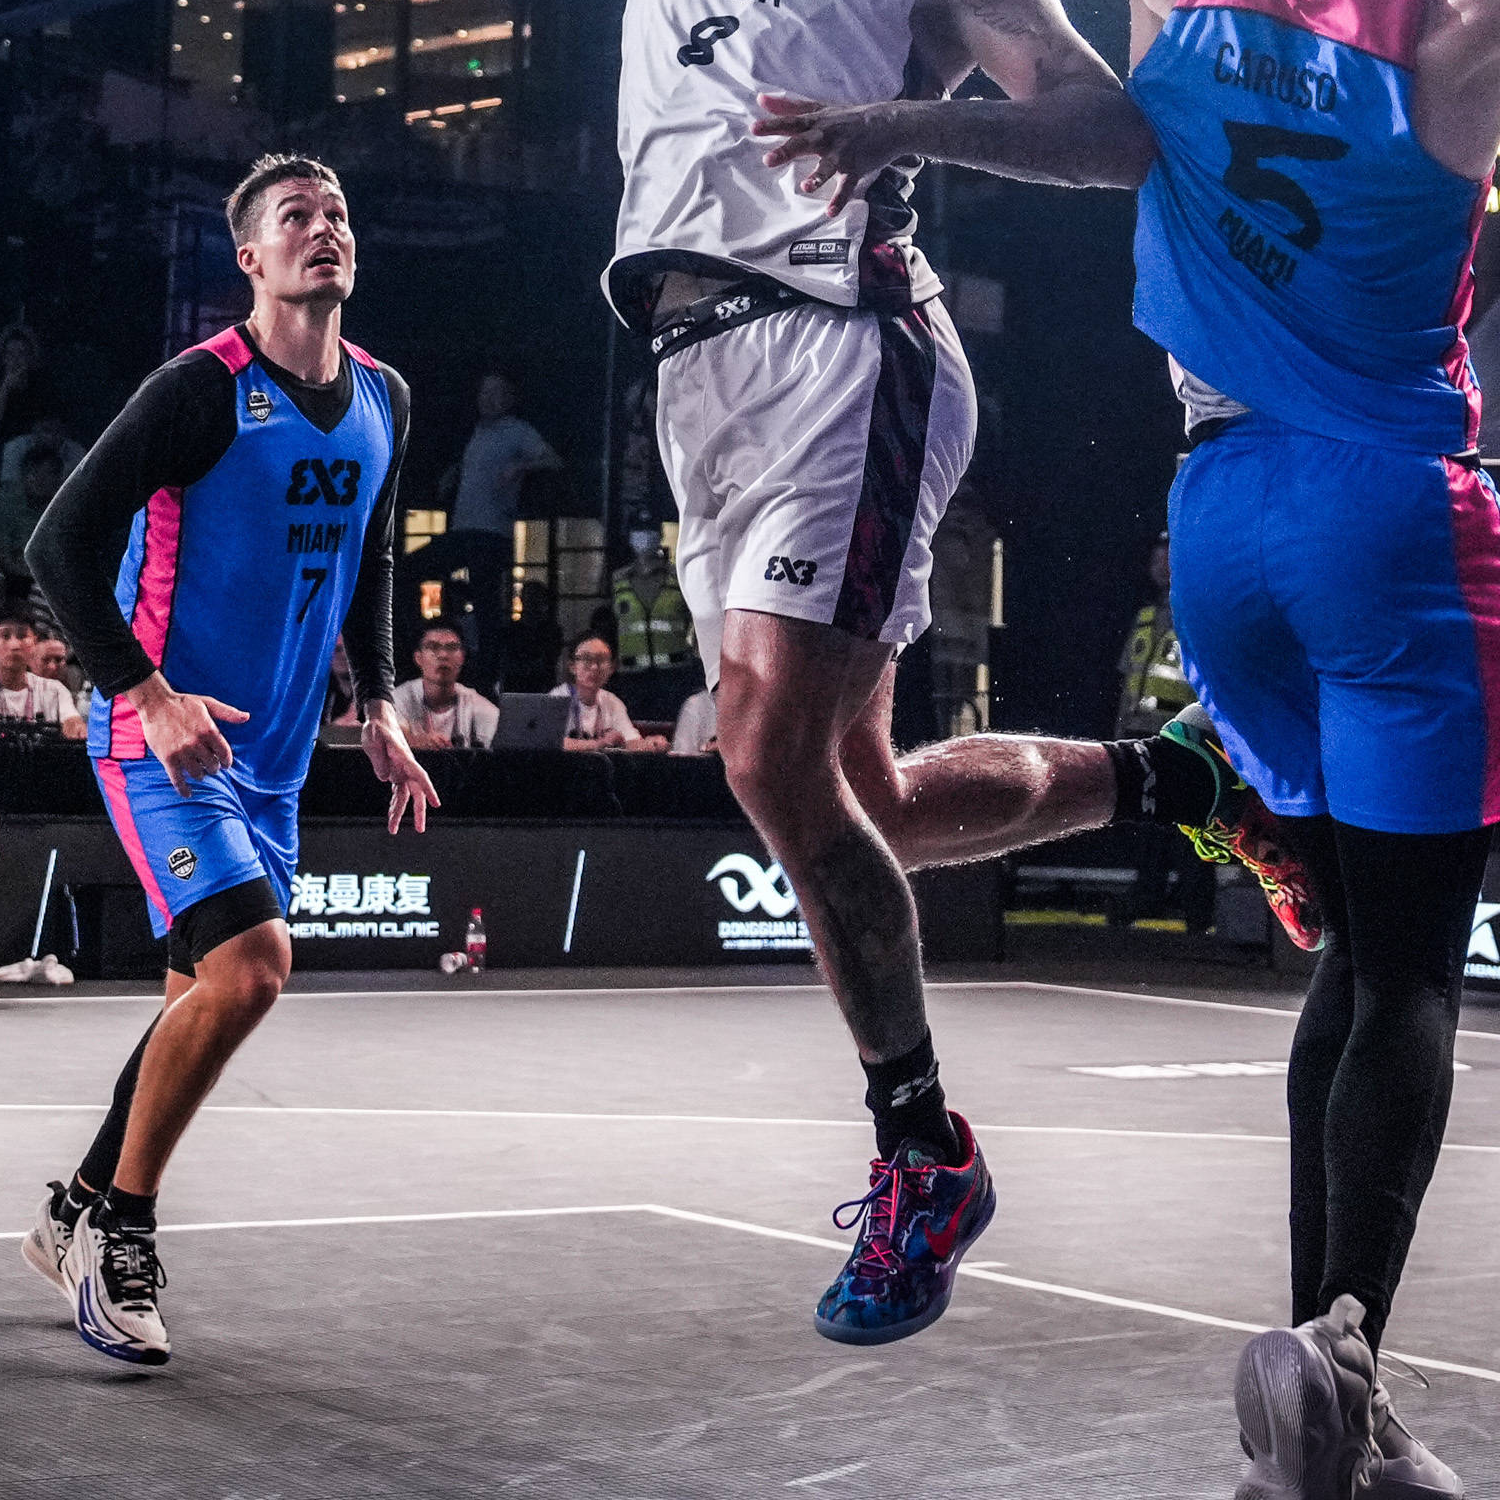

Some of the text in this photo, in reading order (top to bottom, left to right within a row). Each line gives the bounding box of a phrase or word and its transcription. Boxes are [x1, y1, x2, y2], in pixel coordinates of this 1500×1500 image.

[676, 15, 741, 68] 8
[1213, 41, 1338, 114] CARUSO
[1222, 119, 1352, 252] 5
[1217, 207, 1298, 291] MIAMI
[296, 567, 328, 625] 7
[288, 873, 432, 916] 海曼康复
[379, 922, 441, 938] CLINIC
[718, 921, 797, 939] DONGGUAN
